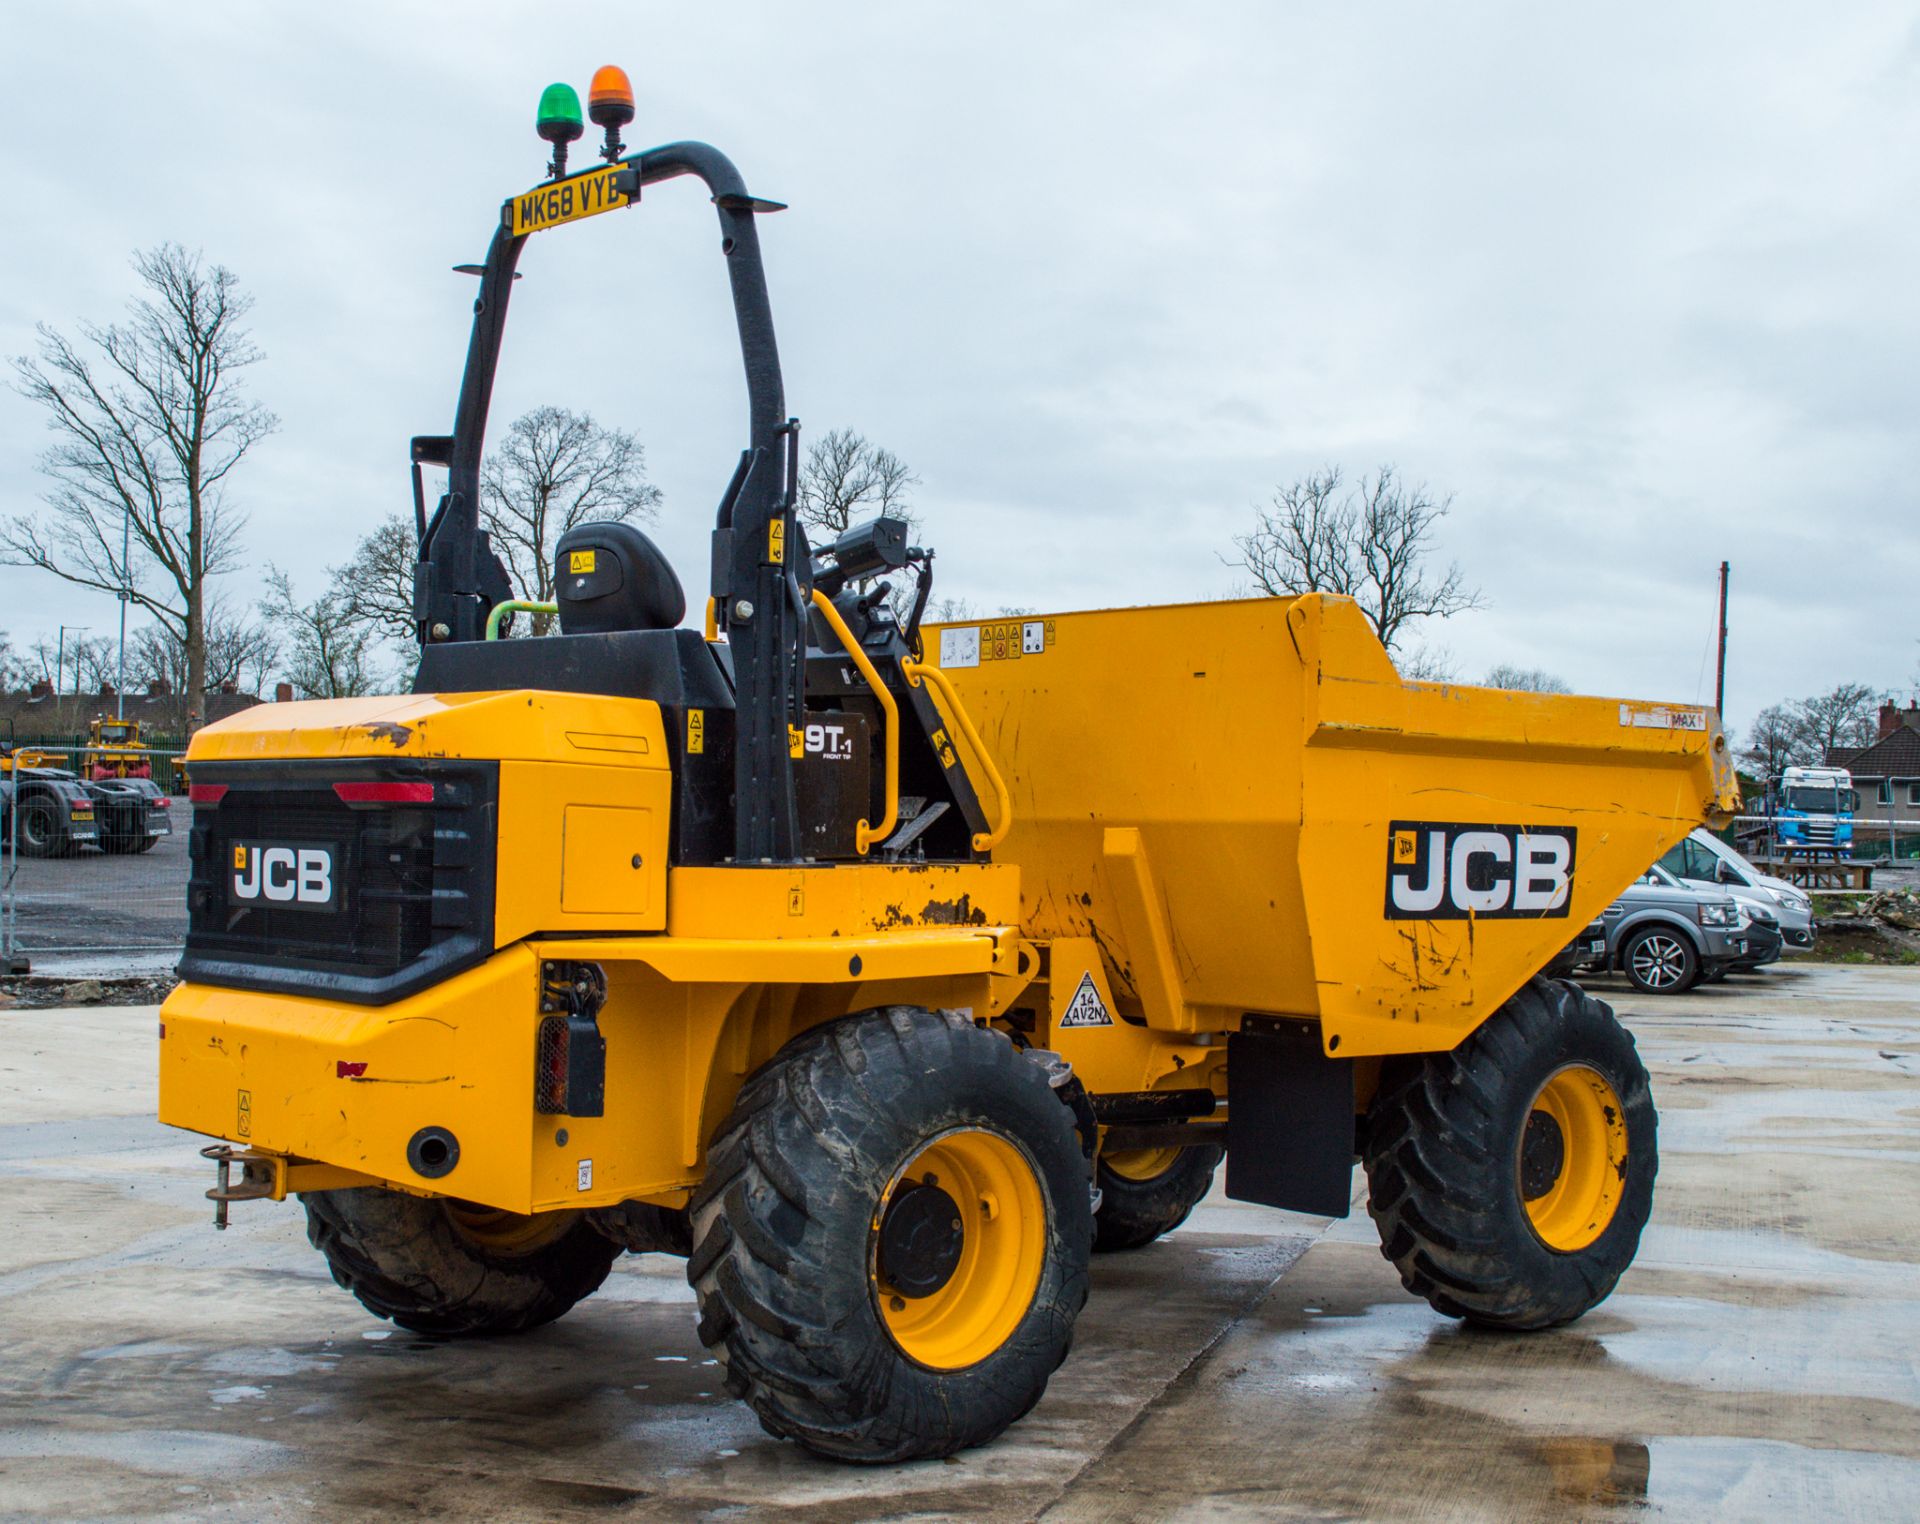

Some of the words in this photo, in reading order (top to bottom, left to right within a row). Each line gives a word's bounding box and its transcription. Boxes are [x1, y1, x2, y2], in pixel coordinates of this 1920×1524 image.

[521, 185, 573, 229] MK68
[1671, 713, 1696, 728] MAX
[1399, 839, 1413, 856] JCB
[234, 847, 332, 904] JCB
[1392, 831, 1571, 911] JCB
[1080, 992, 1094, 1006] 14
[1072, 1007, 1103, 1020] AV2N
